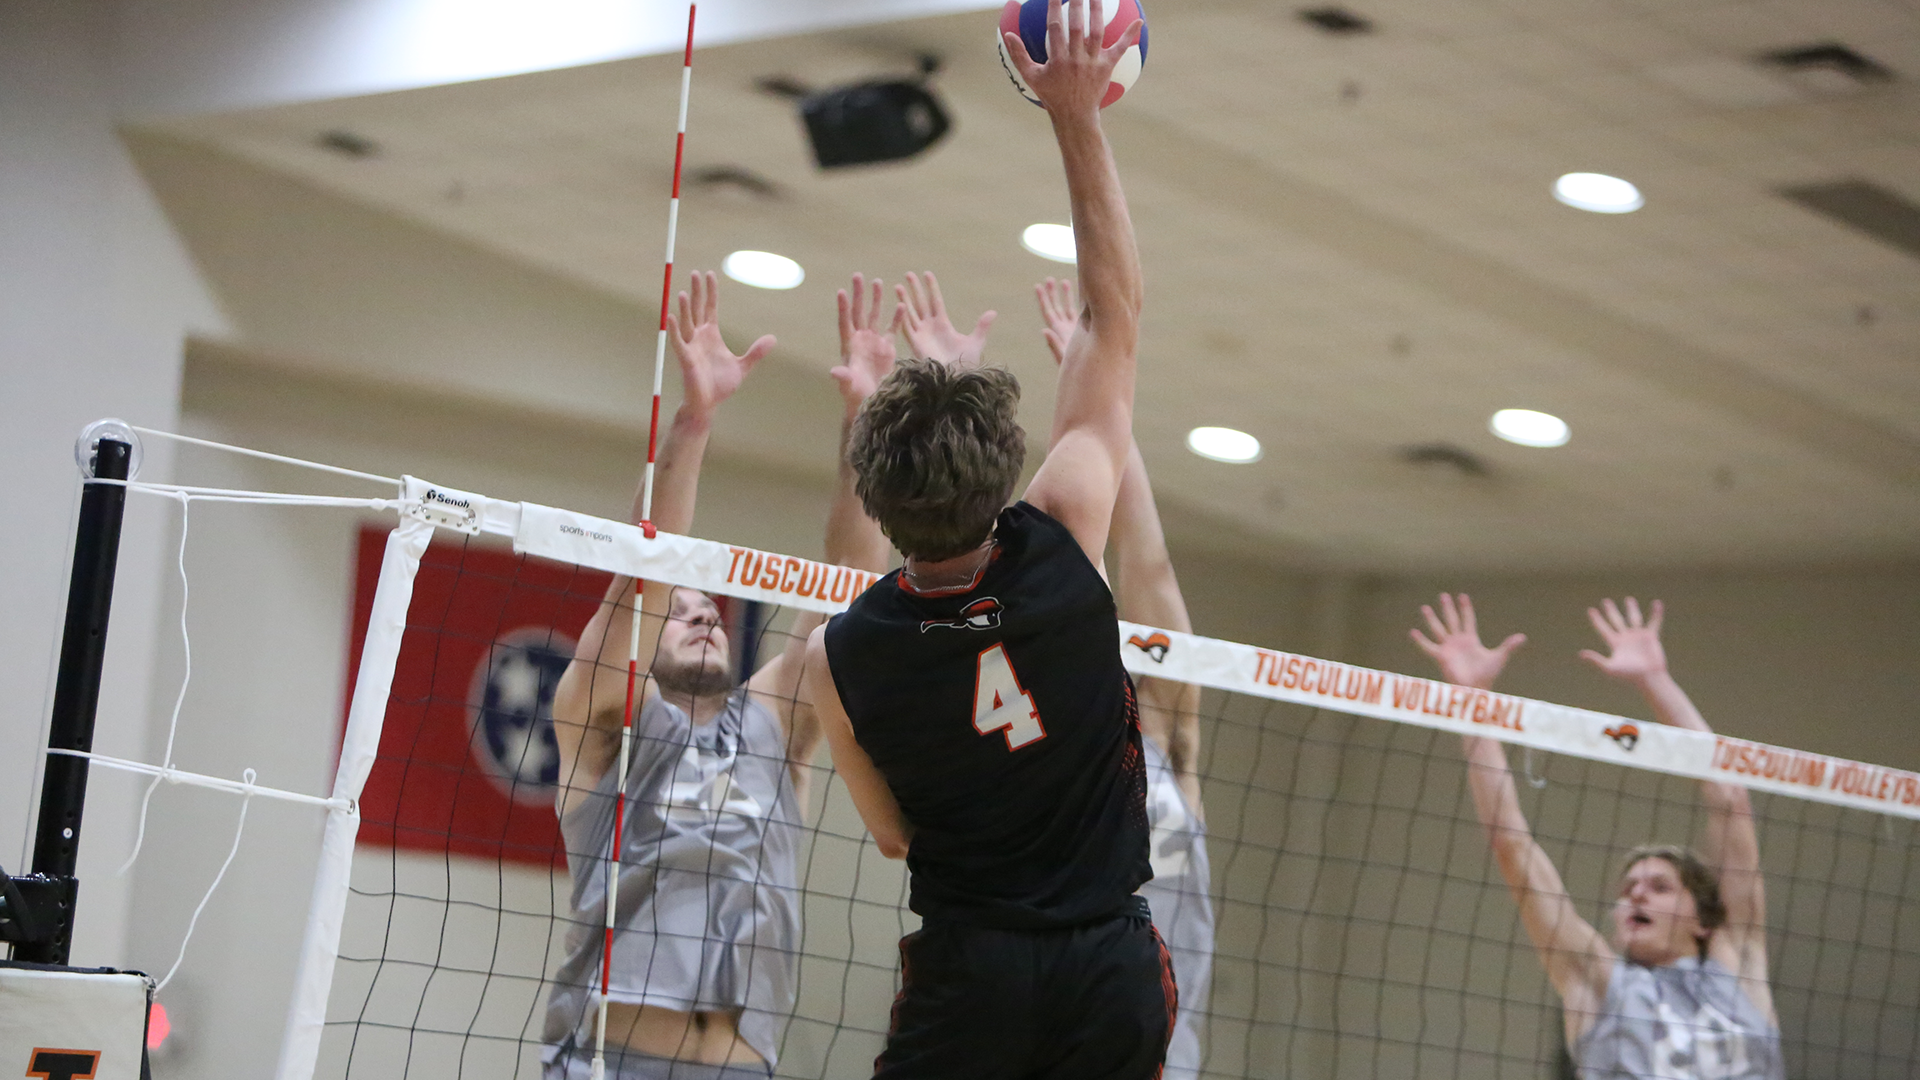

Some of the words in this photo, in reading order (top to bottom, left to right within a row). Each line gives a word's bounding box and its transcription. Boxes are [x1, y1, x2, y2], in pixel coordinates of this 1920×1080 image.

[437, 492, 470, 509] Senoh
[559, 524, 585, 536] sports
[972, 641, 1047, 752] 4
[1253, 650, 1385, 705] TUSCULUM
[1392, 674, 1525, 732] VOLLEYBALL
